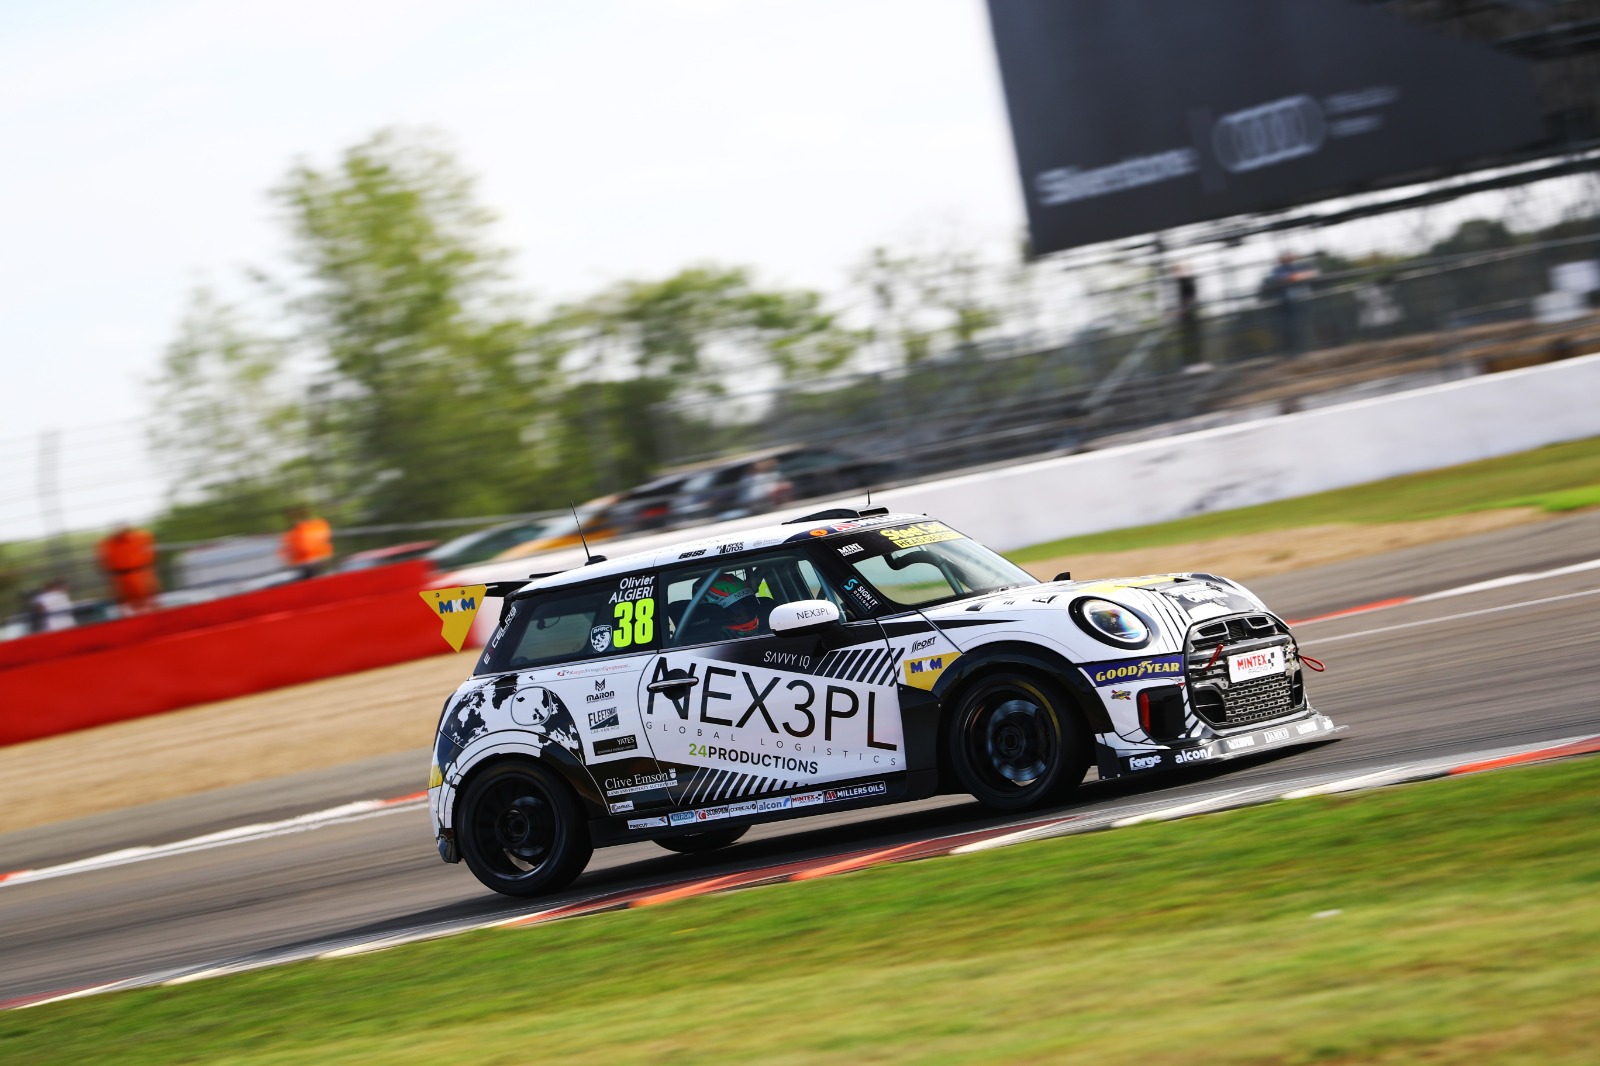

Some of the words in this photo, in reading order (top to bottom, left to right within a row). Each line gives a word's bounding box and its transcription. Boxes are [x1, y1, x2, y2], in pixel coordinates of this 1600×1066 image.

[838, 543, 861, 554] MINI
[619, 575, 655, 589] Olivier
[608, 585, 654, 604] ALGIERI
[853, 590, 872, 610] DESIGNS
[857, 585, 872, 601] SIGN
[438, 597, 476, 614] MKM
[796, 607, 831, 620] NEX3PL
[613, 598, 655, 648] 38
[763, 651, 796, 665] SAVVY
[799, 656, 811, 669] IQ
[910, 657, 943, 674] MKM
[1237, 654, 1268, 671] MINTEX
[646, 656, 898, 751] NEX3PL
[616, 737, 635, 745] YATES
[645, 721, 736, 742] GLOBAL
[760, 737, 897, 766] LOGISTICS
[688, 743, 819, 774] 24PRODUCTIONS
[1175, 749, 1207, 763] alcon
[604, 777, 633, 790] Clive
[634, 771, 669, 785] Emson
[792, 794, 815, 803] MINTEX
[837, 787, 867, 798] MILLERS
[868, 784, 885, 793] OILS
[706, 806, 729, 817] SCORPION
[758, 801, 782, 811] alcon
[672, 812, 693, 821] NITRON
